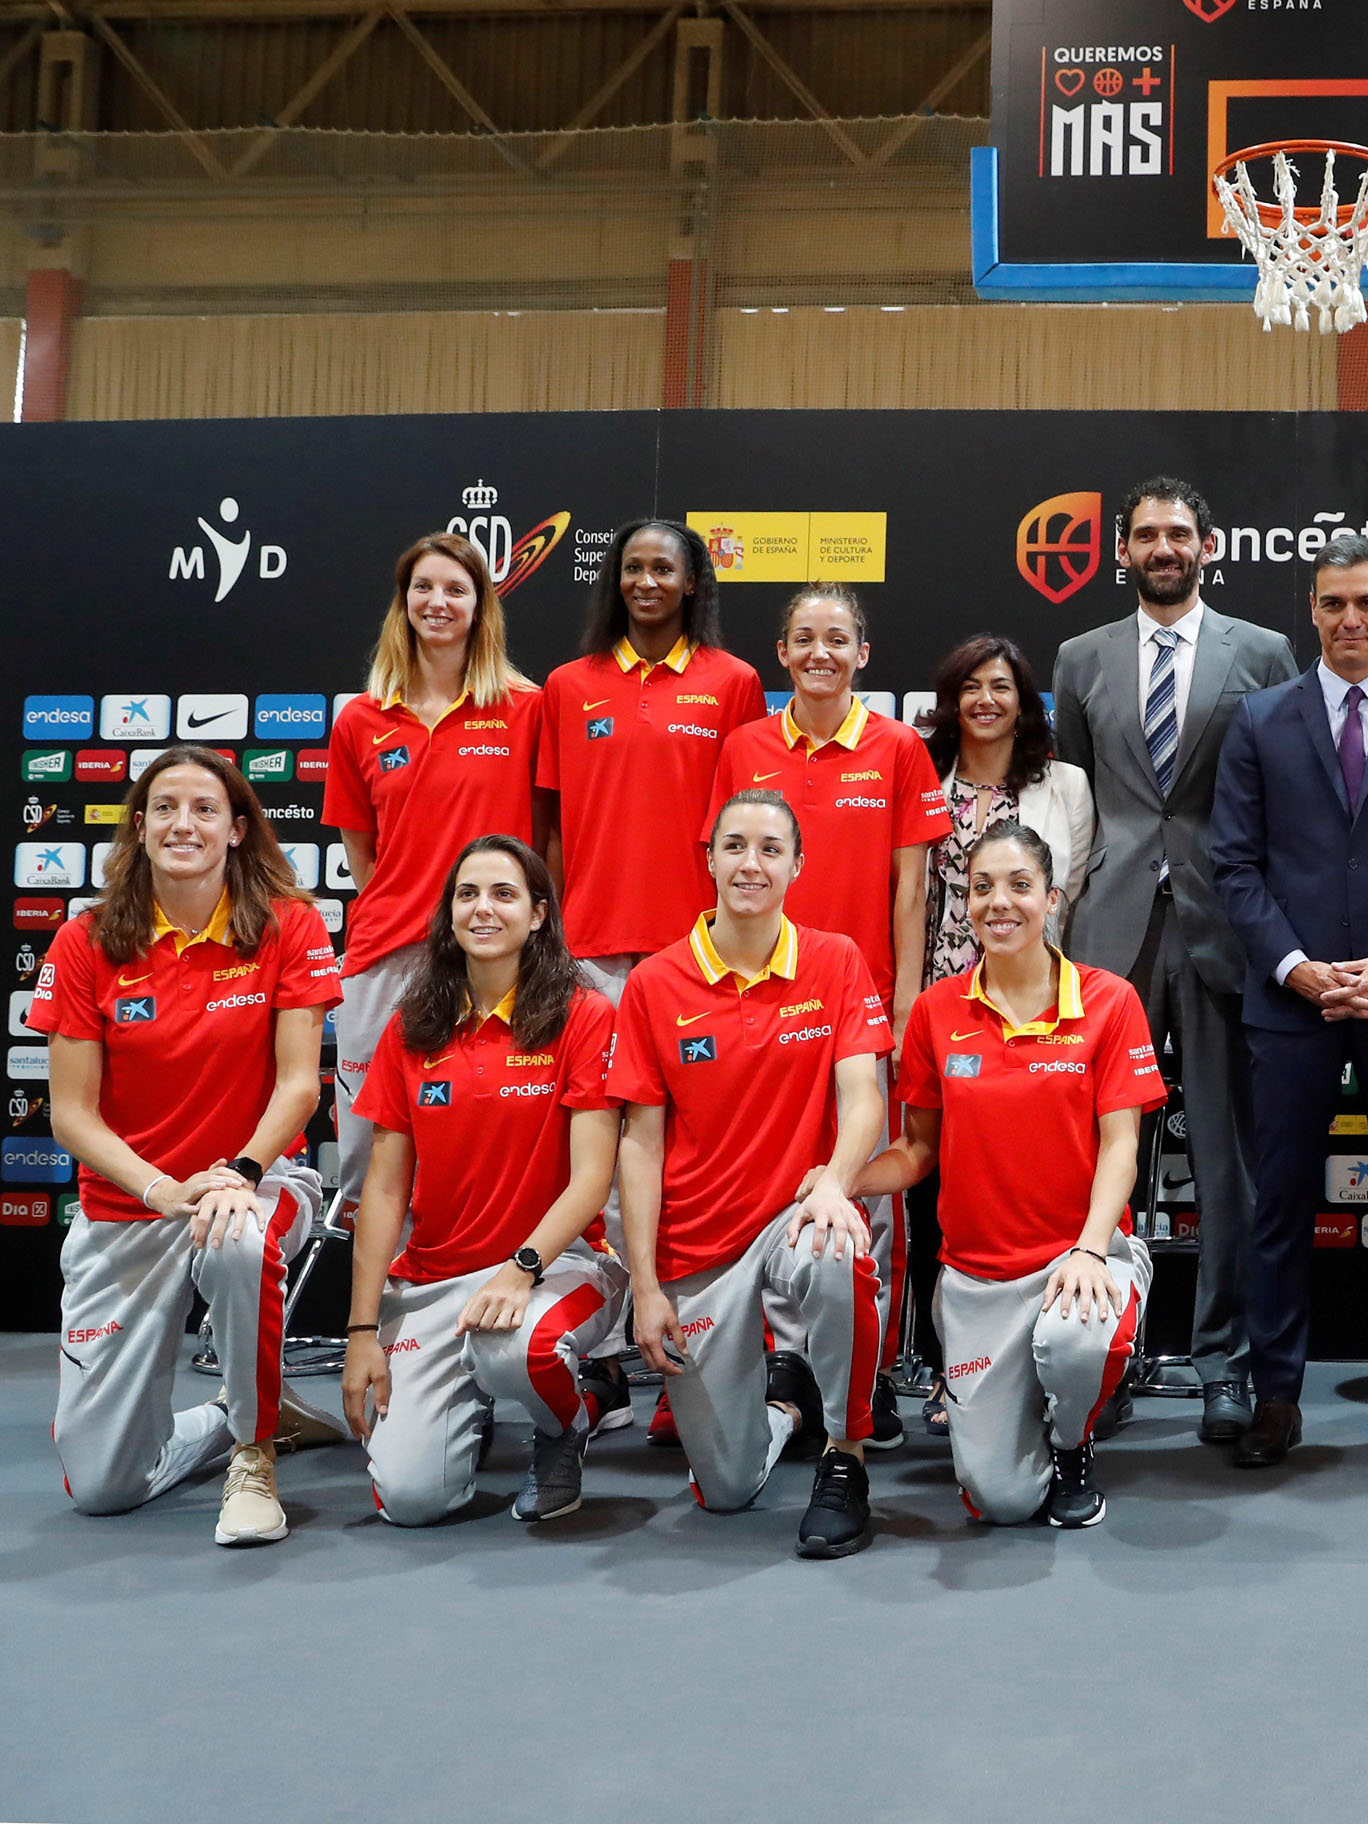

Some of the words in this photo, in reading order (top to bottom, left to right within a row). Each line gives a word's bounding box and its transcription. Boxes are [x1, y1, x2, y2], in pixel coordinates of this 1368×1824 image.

[1054, 46, 1163, 63] QUEREMOS
[575, 528, 617, 548] Consej
[752, 537, 798, 545] GOBIERNO
[819, 537, 868, 545] MINISTERIO
[752, 546, 765, 554] DE
[766, 545, 798, 554] ESPAÑA
[819, 547, 832, 555] DE
[833, 547, 873, 555] CULTURA
[819, 556, 825, 564] Y
[827, 556, 865, 564] DEPORTE
[676, 693, 719, 706] ESPAÑA
[26, 708, 91, 724] endesa
[258, 707, 324, 723] endesa
[464, 718, 508, 730] ESPAÑA
[112, 727, 156, 737] CaixaBank
[667, 723, 718, 739] endesa
[458, 744, 510, 756] endesa
[78, 761, 111, 769] IBERIA
[840, 769, 883, 782] ESPAÑA
[835, 795, 886, 808] endesa
[23, 804, 43, 824] CSD
[261, 804, 315, 819] oncesto
[926, 805, 948, 816] IBER
[27, 876, 72, 885] CaixaBank
[16, 909, 49, 917] IBERIA
[16, 952, 35, 972] CSD
[213, 962, 261, 982] ESPAÑA
[206, 992, 266, 1012] endesa
[779, 998, 824, 1018] ESPAÑA
[778, 1024, 832, 1044] endesa
[10, 1056, 49, 1065] santaluc
[506, 1053, 554, 1067] ESPAÑA
[1029, 1060, 1086, 1075] endesa
[1134, 1064, 1159, 1076] IBER
[8, 1098, 28, 1117] CSD
[4, 1150, 70, 1166] endesa
[1314, 1226, 1340, 1234] ERIA
[382, 1338, 421, 1357] SPAÑA
[948, 1356, 992, 1380] ESPAÑA
